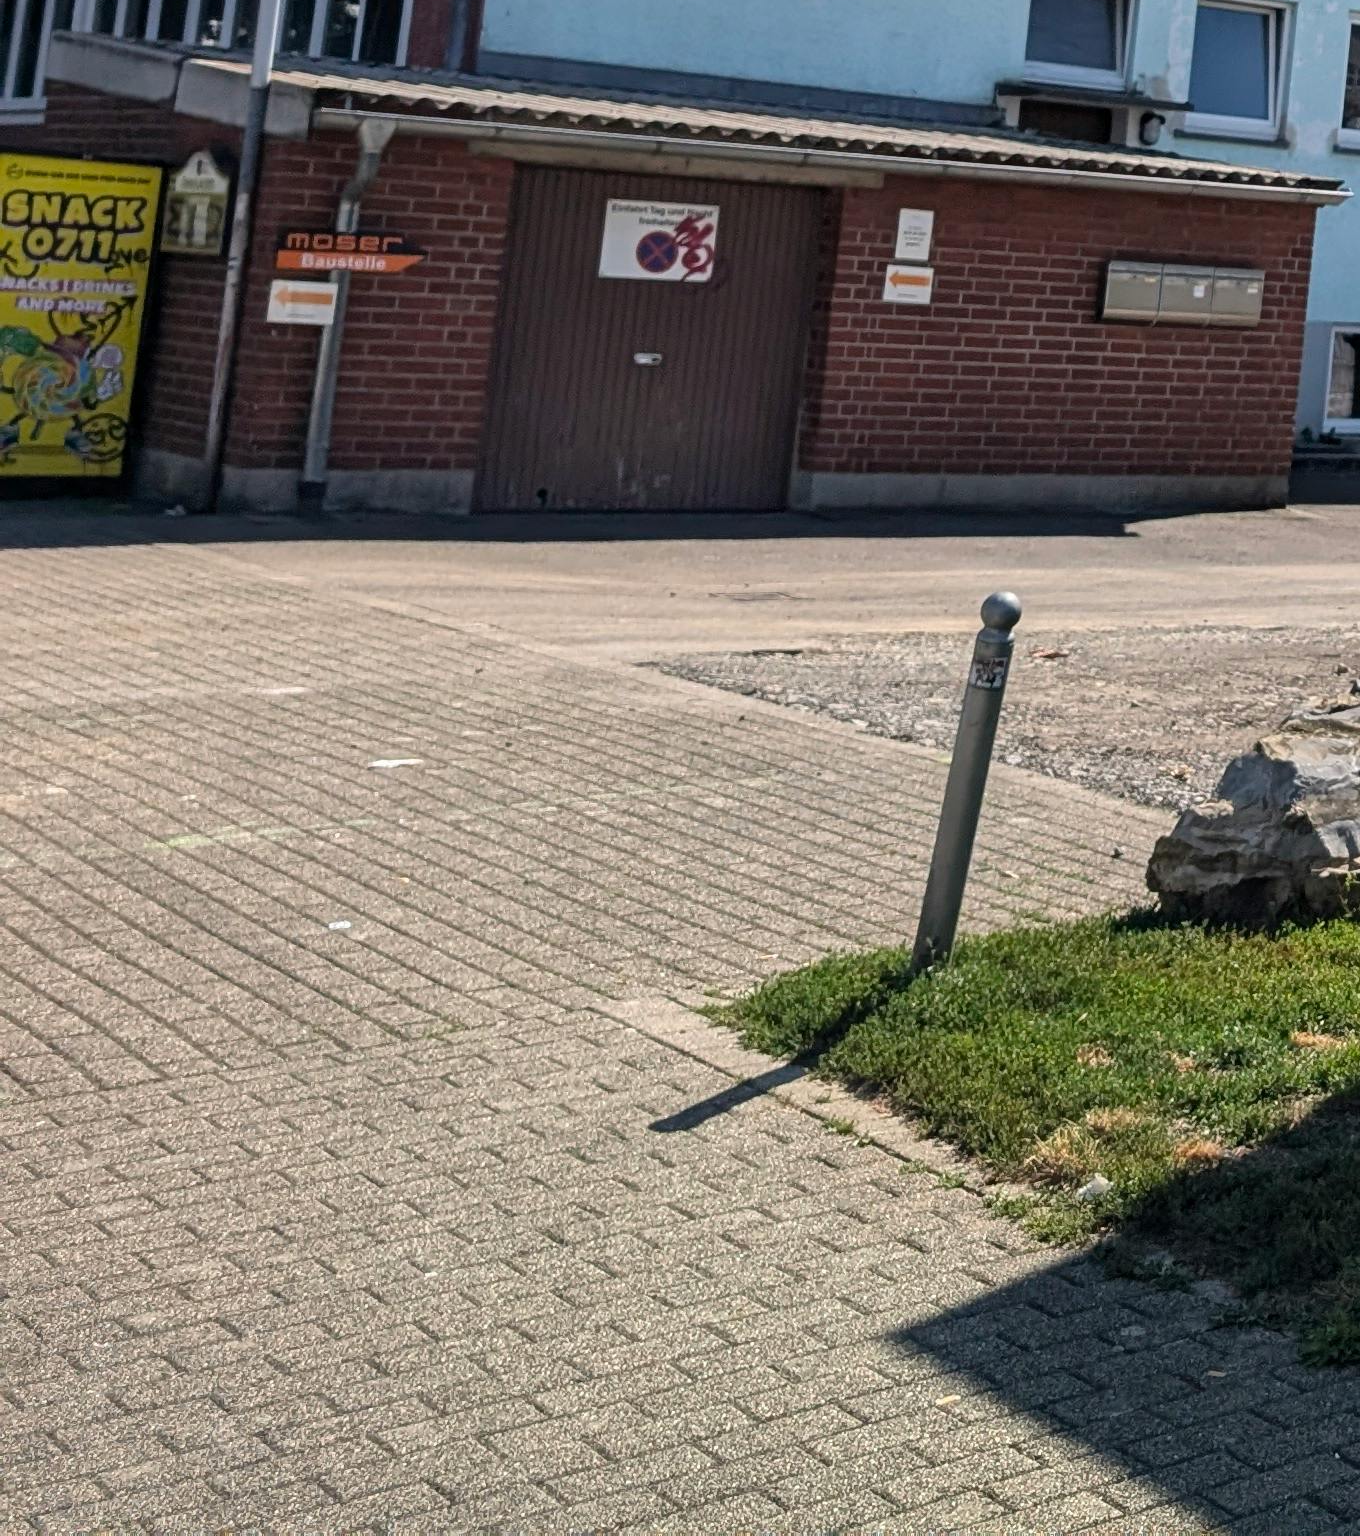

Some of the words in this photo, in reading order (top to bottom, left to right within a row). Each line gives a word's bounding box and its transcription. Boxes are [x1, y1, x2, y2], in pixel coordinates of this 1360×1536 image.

[2, 189, 148, 233] SNACK
[22, 226, 116, 264] 0711
[287, 232, 403, 252] moser
[302, 252, 387, 270] Baustelle
